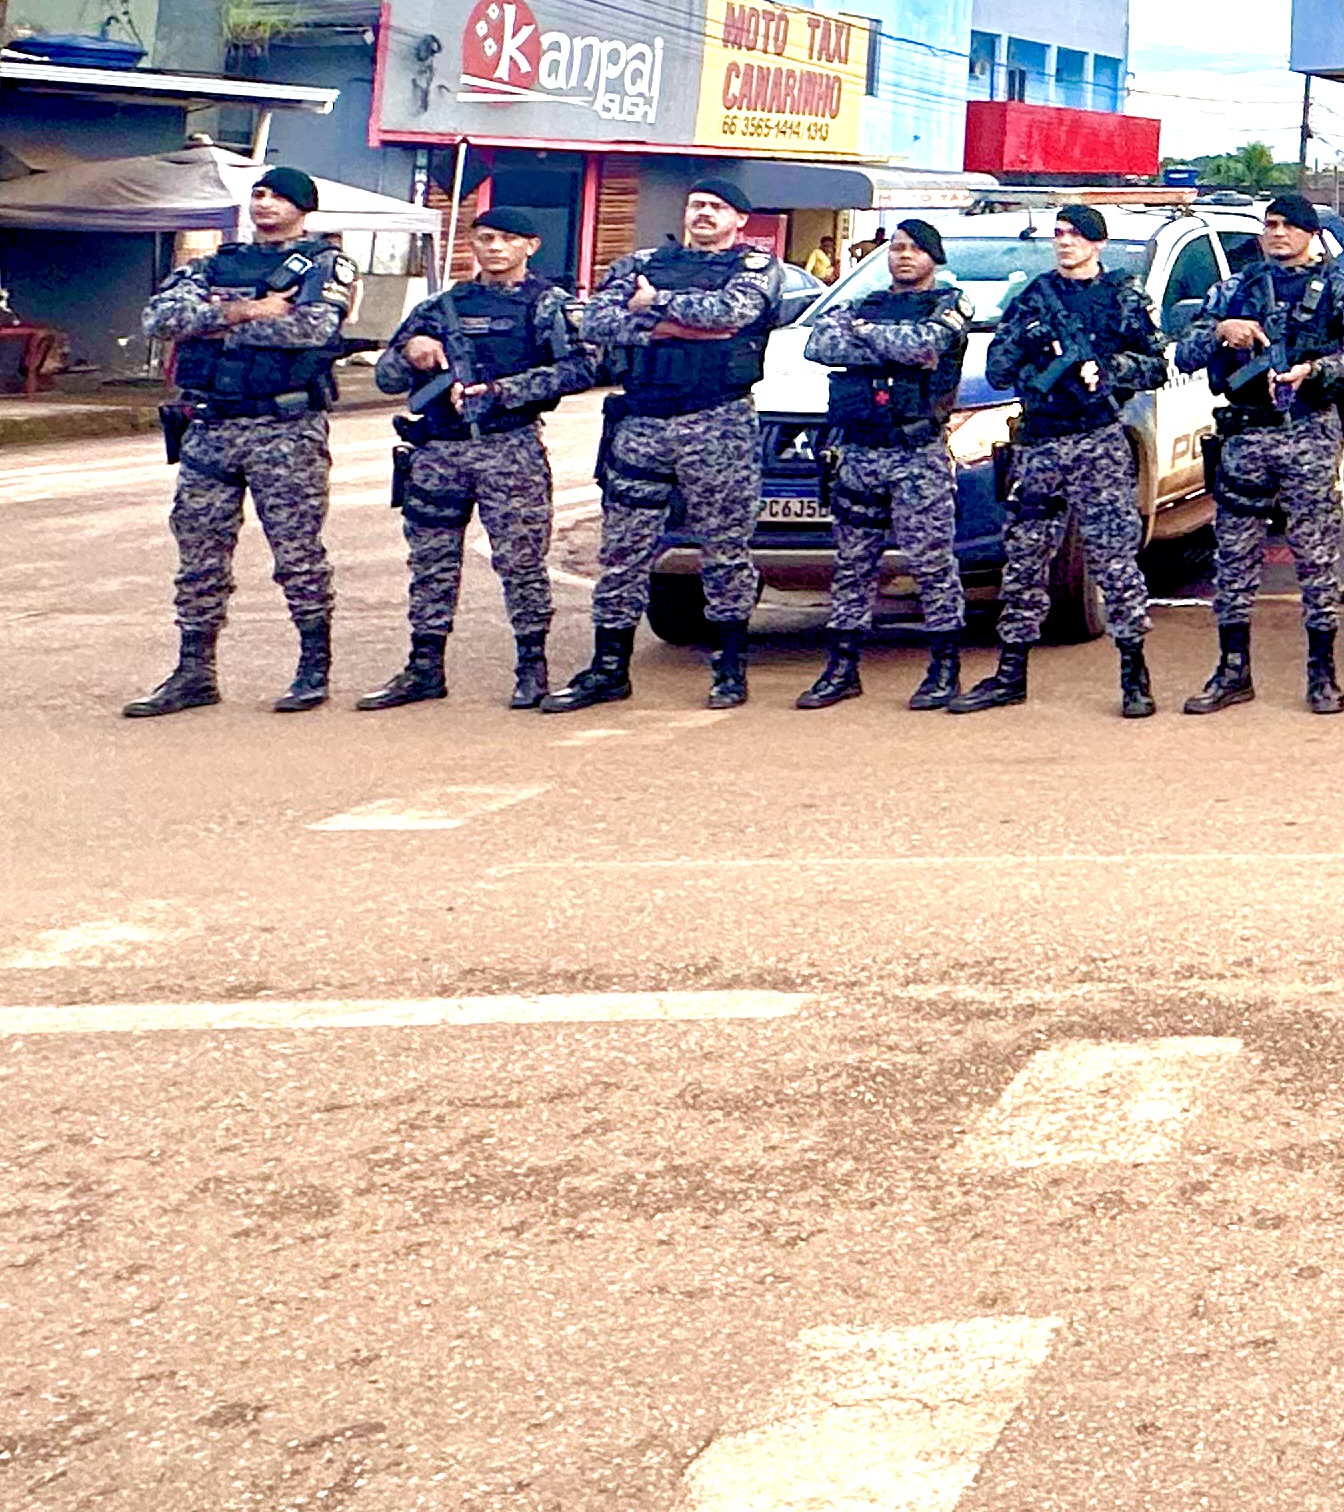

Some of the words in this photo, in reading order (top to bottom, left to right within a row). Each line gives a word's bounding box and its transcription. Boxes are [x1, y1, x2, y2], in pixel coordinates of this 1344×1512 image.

[723, 1, 789, 56] MOTO
[807, 17, 850, 65] TAXI
[722, 60, 842, 119] CANARINHO
